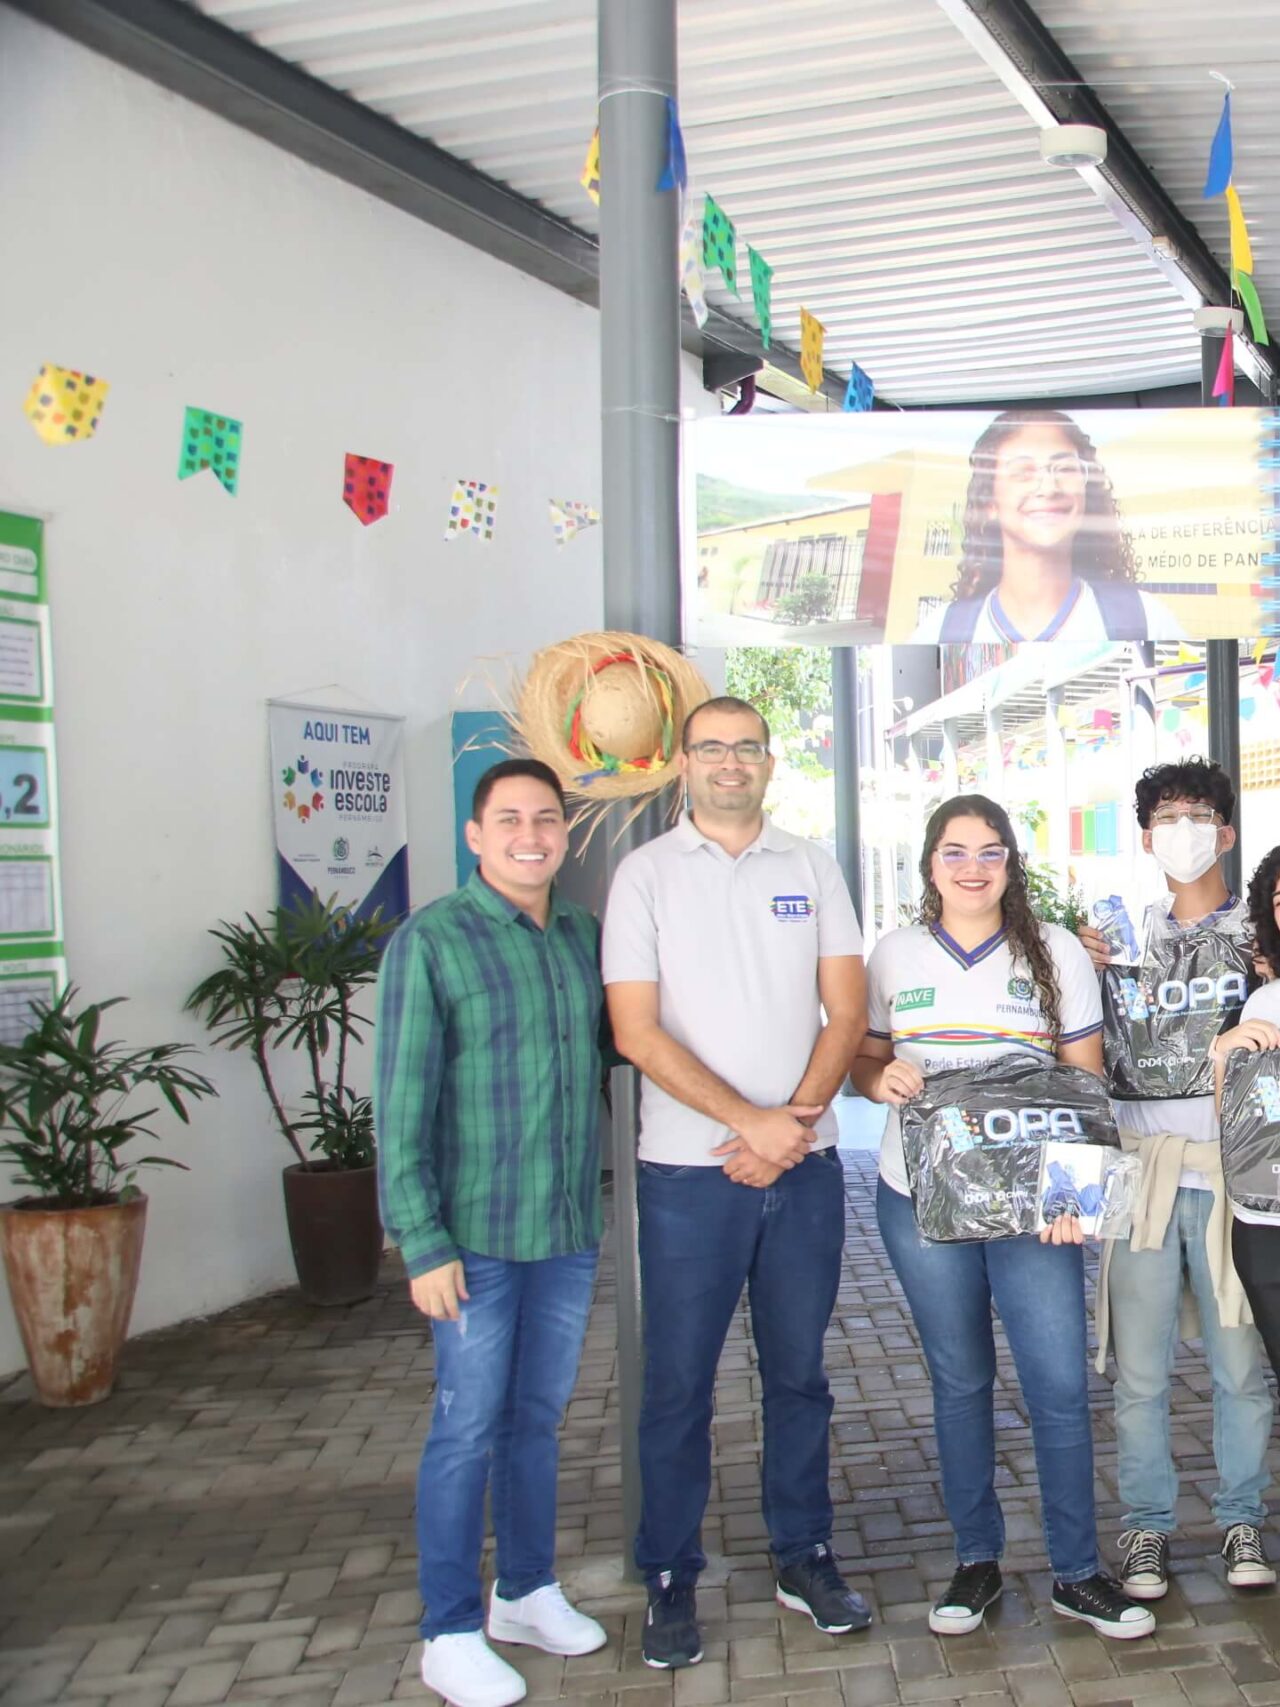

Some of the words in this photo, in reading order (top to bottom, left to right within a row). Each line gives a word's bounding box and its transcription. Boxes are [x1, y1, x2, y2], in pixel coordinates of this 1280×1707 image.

[1151, 525, 1168, 540] DE
[1173, 516, 1276, 539] REFERÊNCIA
[1149, 550, 1192, 569] MÉDIO
[1198, 553, 1217, 568] DE
[304, 721, 338, 743] AQUI
[342, 725, 371, 745] TEM
[777, 900, 806, 913] ETE
[896, 989, 934, 1005] NAVE
[1158, 970, 1248, 1012] OPA
[924, 1057, 953, 1070] Rede
[984, 1107, 1084, 1142] OPA
